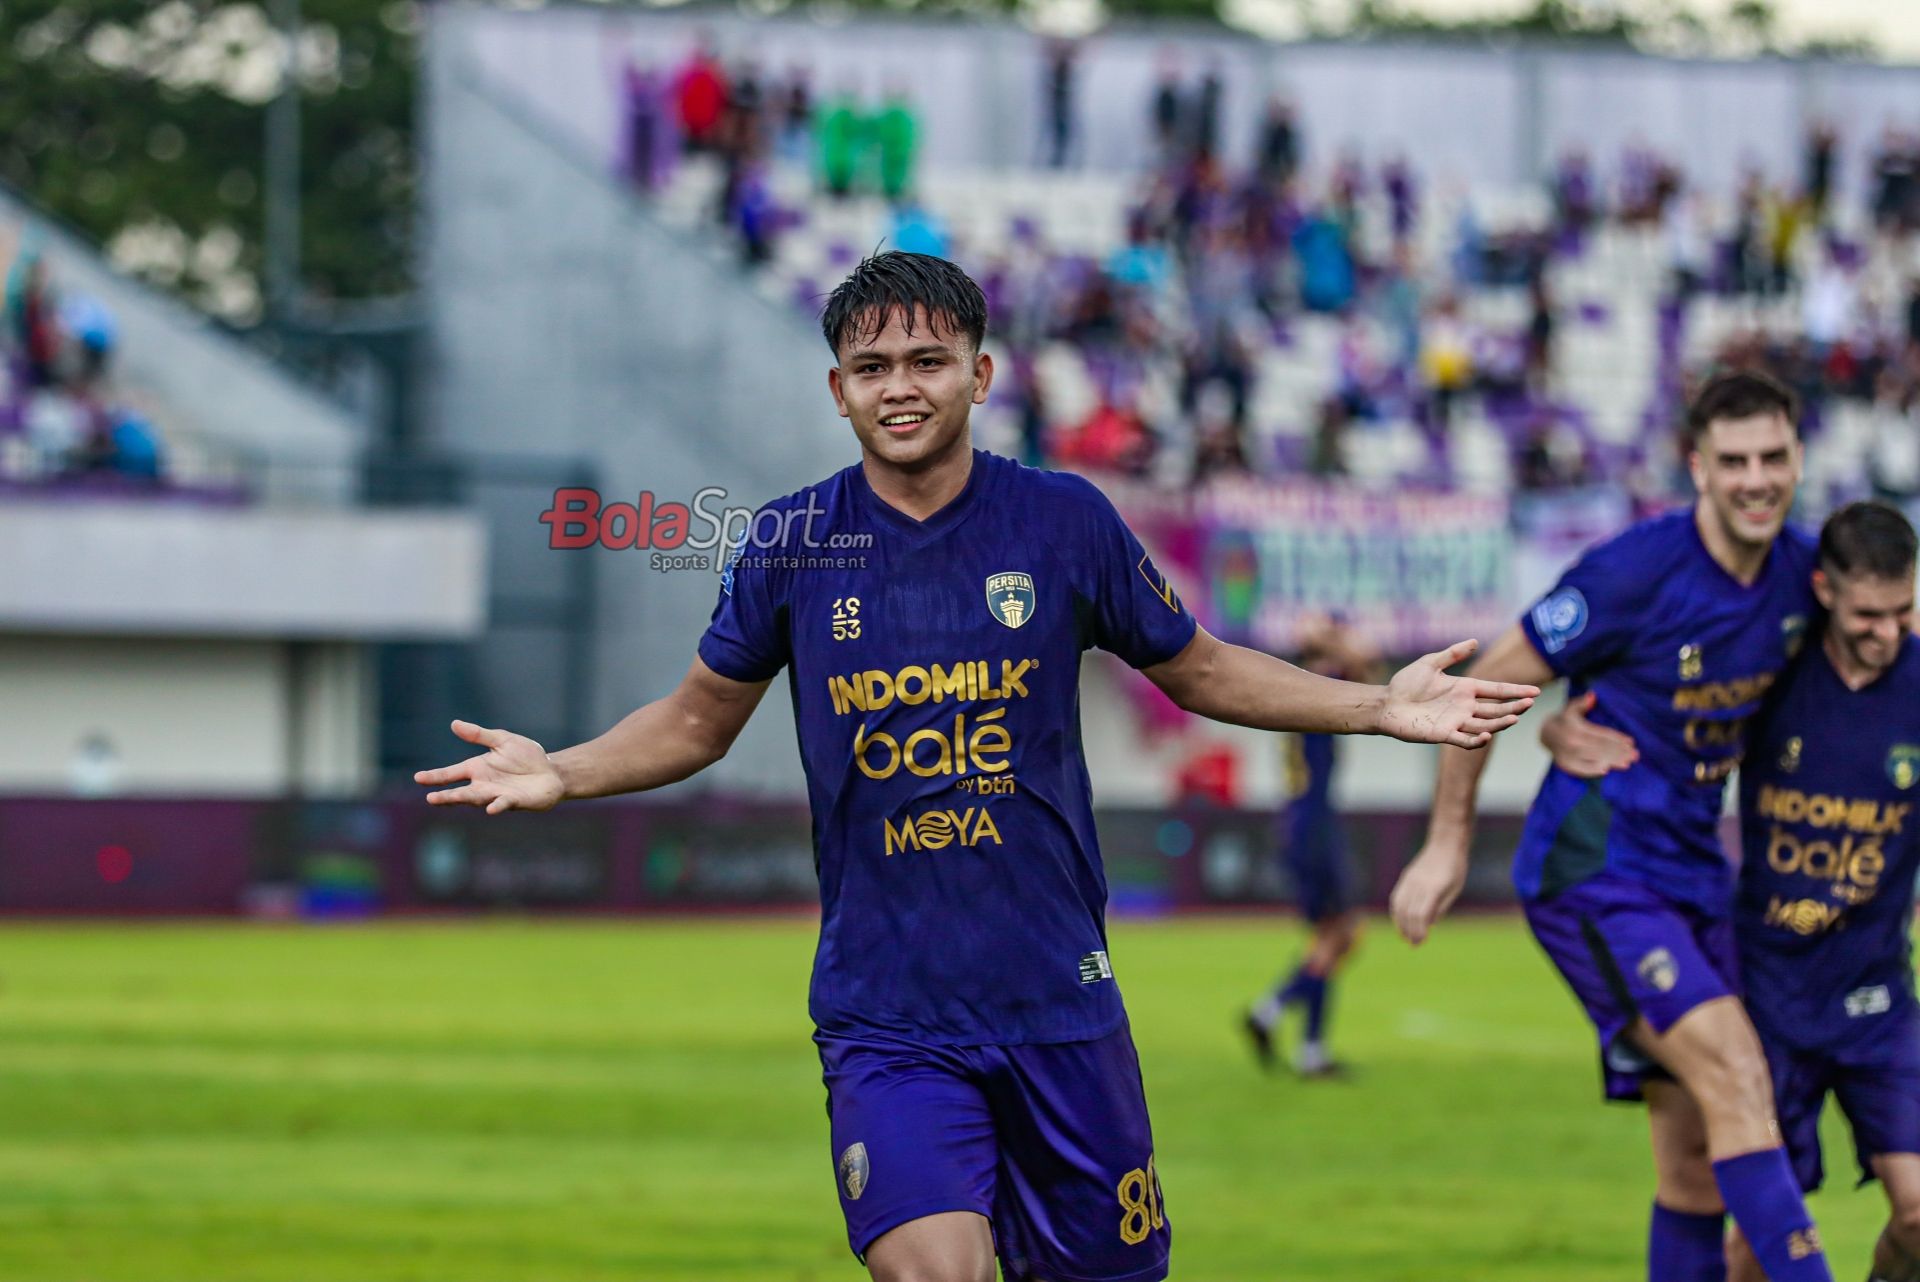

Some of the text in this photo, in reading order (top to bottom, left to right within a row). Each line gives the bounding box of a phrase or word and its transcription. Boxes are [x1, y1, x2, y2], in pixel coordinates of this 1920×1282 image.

[989, 575, 1031, 592] PERSITA
[854, 707, 1012, 780] balé
[884, 807, 1003, 856] MOYA
